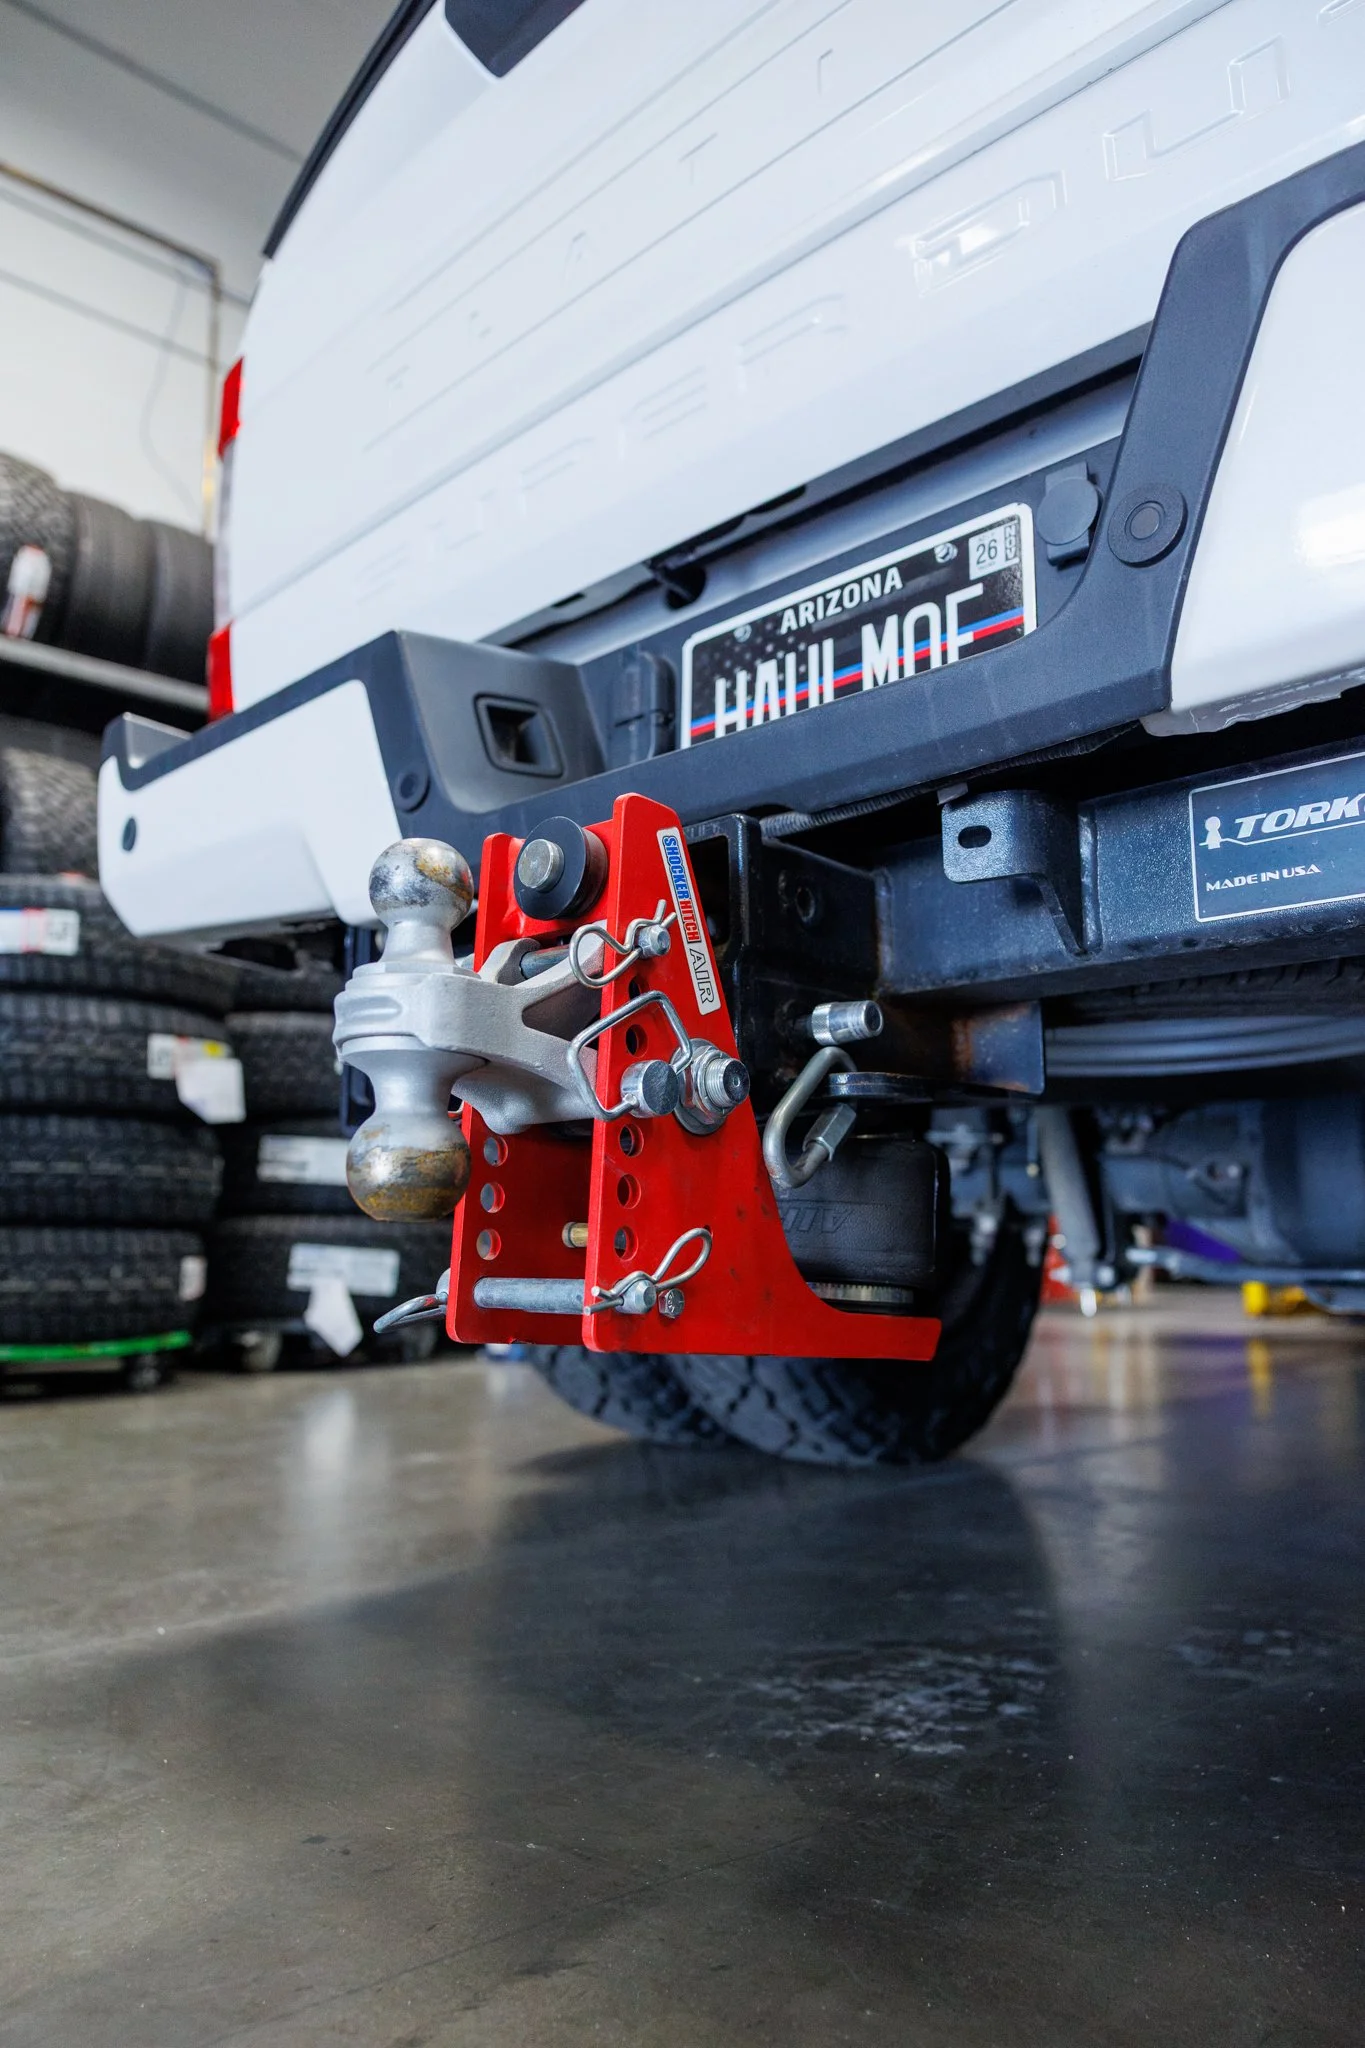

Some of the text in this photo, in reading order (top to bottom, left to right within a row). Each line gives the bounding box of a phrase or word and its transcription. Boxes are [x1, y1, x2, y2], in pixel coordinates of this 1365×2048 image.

[912, 0, 1365, 299] DU
[976, 538, 998, 565] 26
[1005, 524, 1017, 561] NOV
[780, 567, 903, 634] ARIZONA
[1234, 792, 1365, 839] TORK
[1206, 863, 1321, 891] MADE IN USA
[689, 948, 714, 1004] AIR
